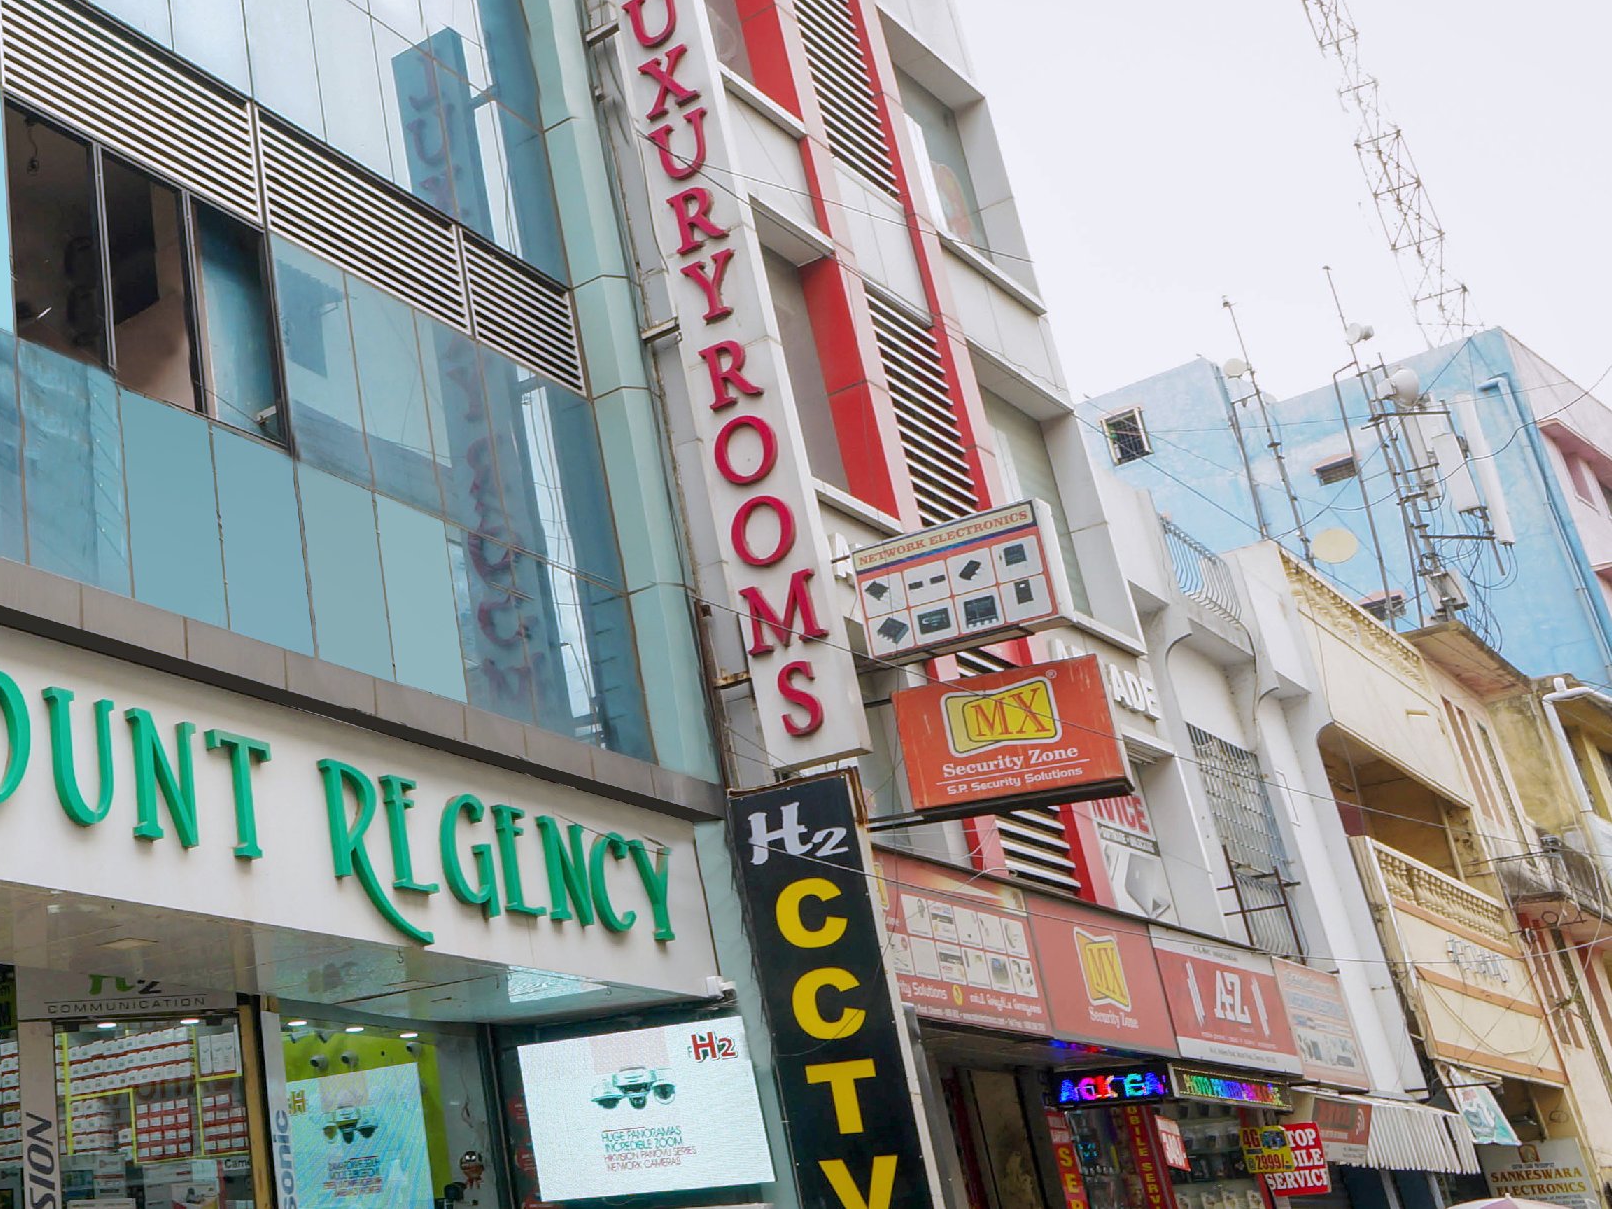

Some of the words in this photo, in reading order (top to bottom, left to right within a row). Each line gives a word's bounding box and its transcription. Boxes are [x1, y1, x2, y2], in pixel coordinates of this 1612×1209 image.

[699, 340, 830, 738] ROOMS
[858, 539, 927, 567] NETWORK
[929, 510, 1029, 550] ELECTRONICS
[971, 687, 1052, 738] MX
[942, 754, 1026, 779] Security
[1027, 744, 1080, 766] Zone
[947, 781, 968, 796] S.P.
[971, 773, 1022, 794] Security
[1024, 765, 1084, 785] Solutions
[317, 758, 675, 945] REGENCY
[748, 801, 849, 865] H2
[47, 997, 206, 1014] COMMUNICATION
[691, 1031, 739, 1062] H2
[775, 877, 899, 1209] CCTV
[1491, 1166, 1583, 1183] SANKESWARA
[1495, 1181, 1587, 1198] ELECTRONICS
